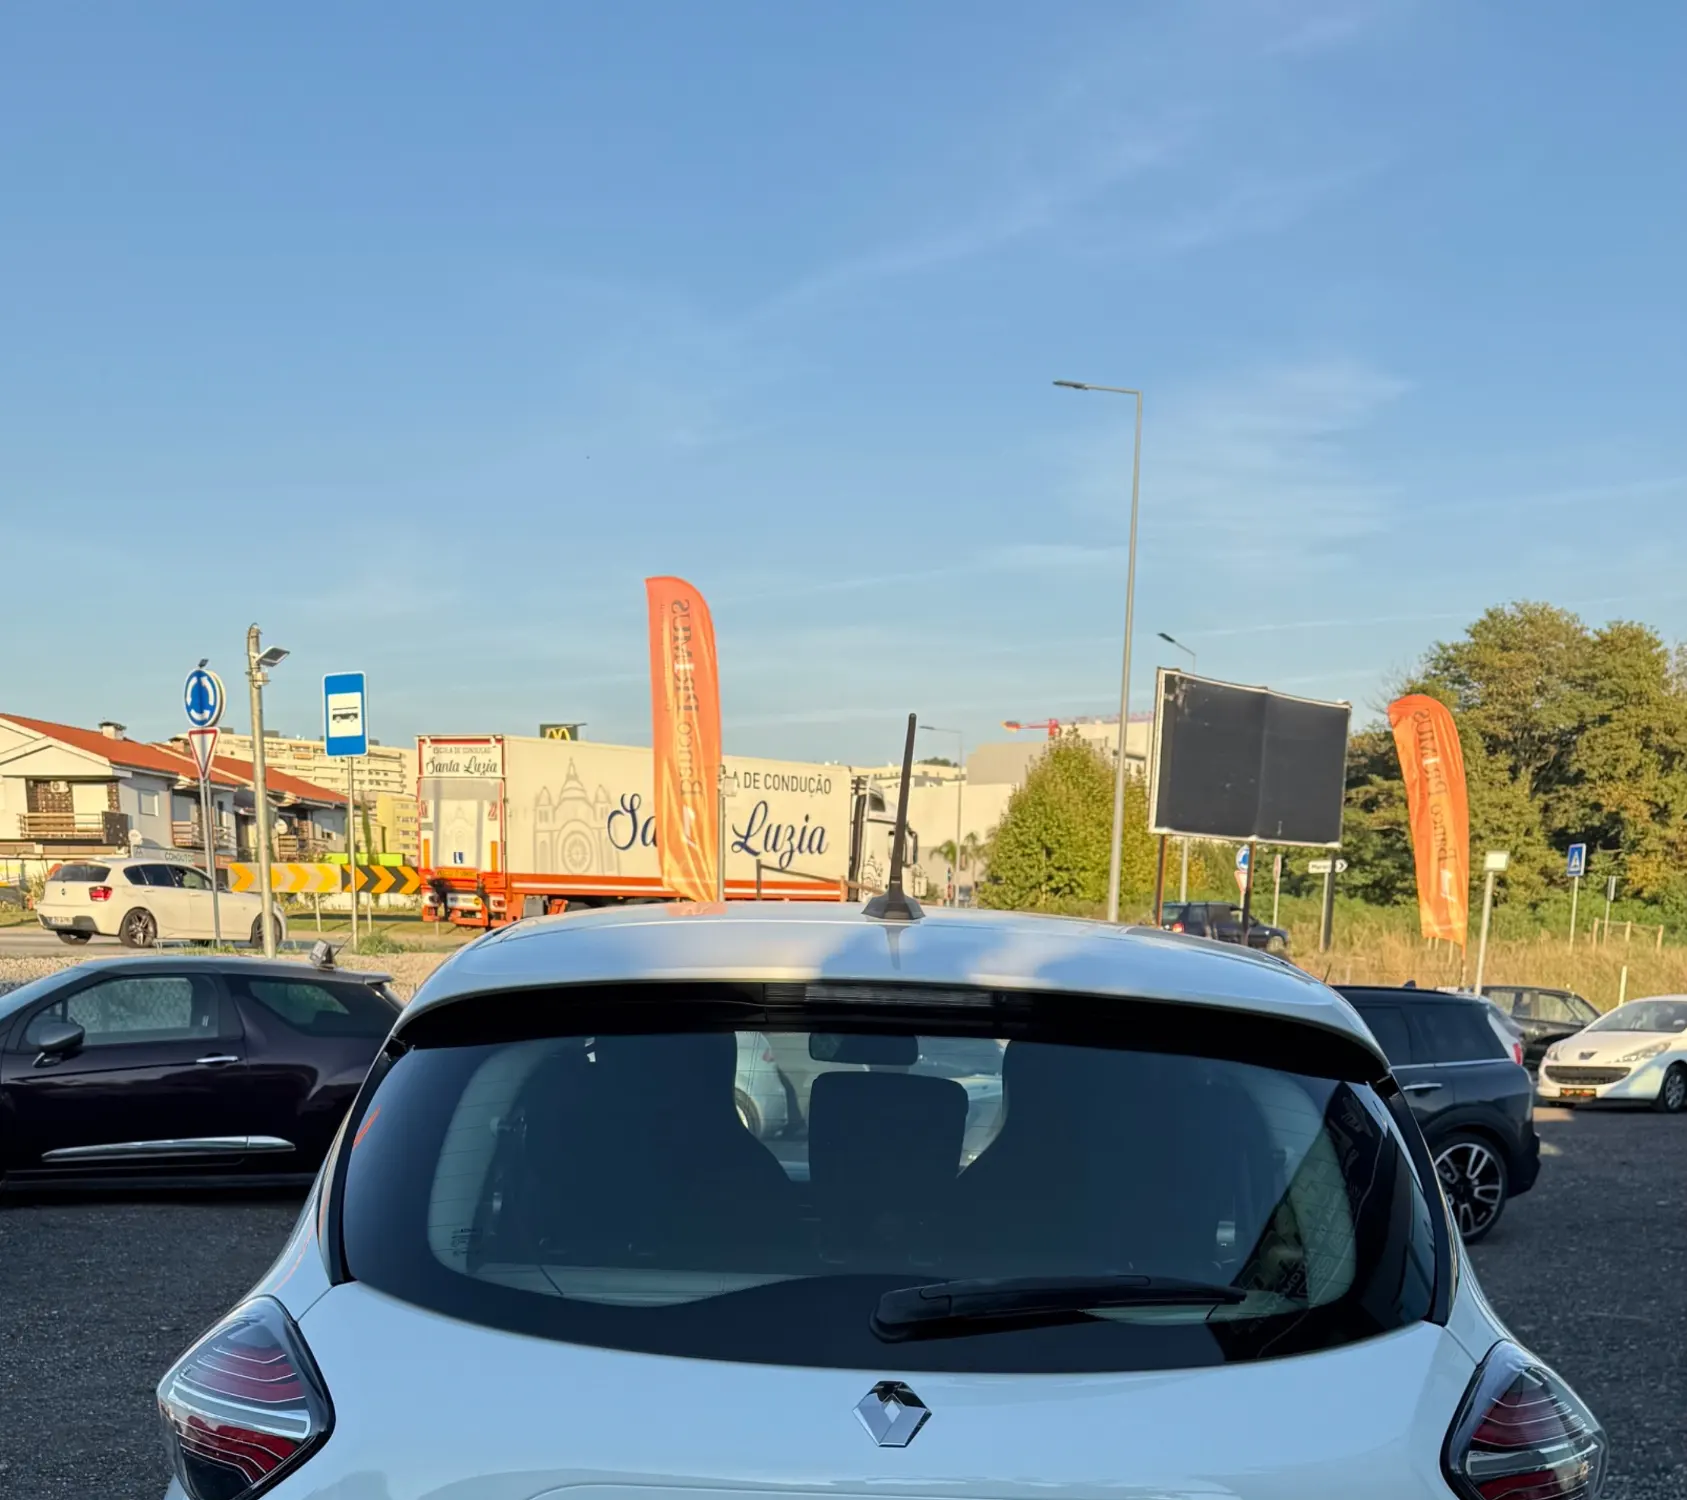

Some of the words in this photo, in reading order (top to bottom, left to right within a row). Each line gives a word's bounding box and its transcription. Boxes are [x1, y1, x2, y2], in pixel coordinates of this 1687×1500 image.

[426, 756, 460, 775] Santa
[464, 755, 498, 776] Luzia
[743, 771, 761, 790] DE
[763, 773, 832, 798] CONDUÇÃO
[731, 800, 829, 870] Luzia
